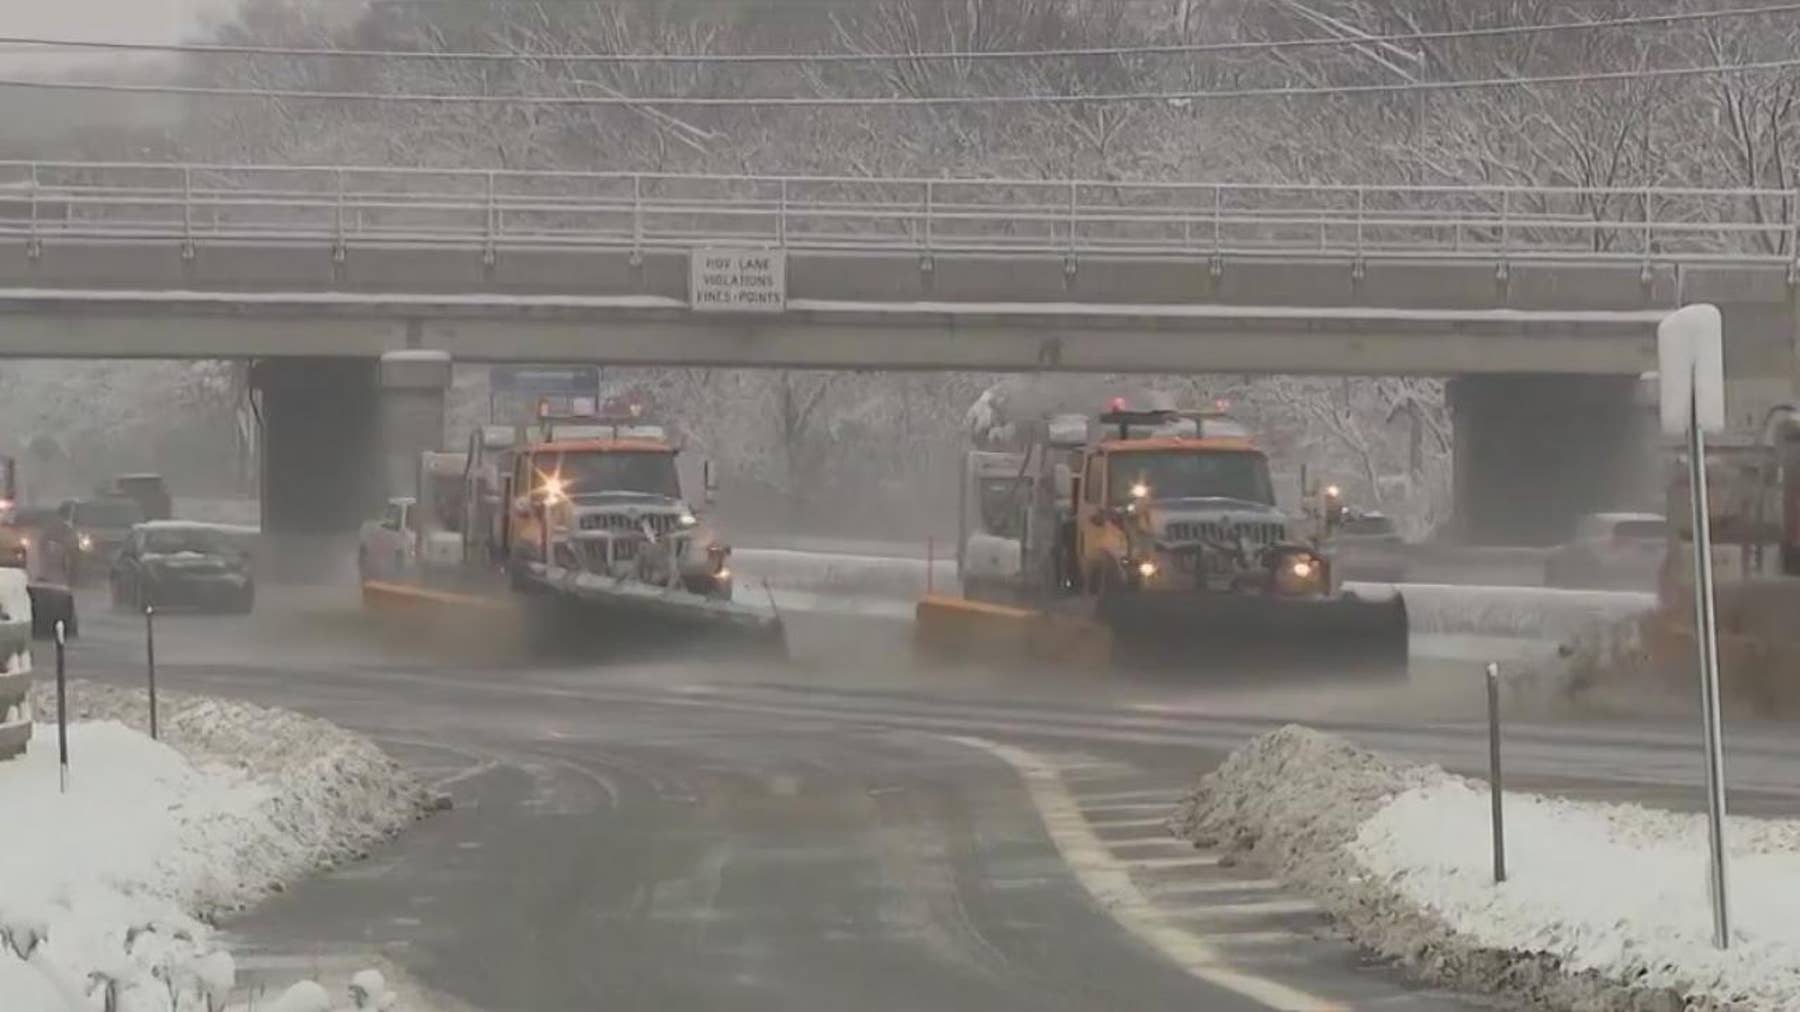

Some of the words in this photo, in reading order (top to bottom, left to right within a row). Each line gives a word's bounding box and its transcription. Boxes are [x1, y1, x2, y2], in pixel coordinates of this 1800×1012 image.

[706, 257, 731, 270] HOV
[739, 257, 770, 270] LANE
[703, 274, 774, 287] VIOLATIONS
